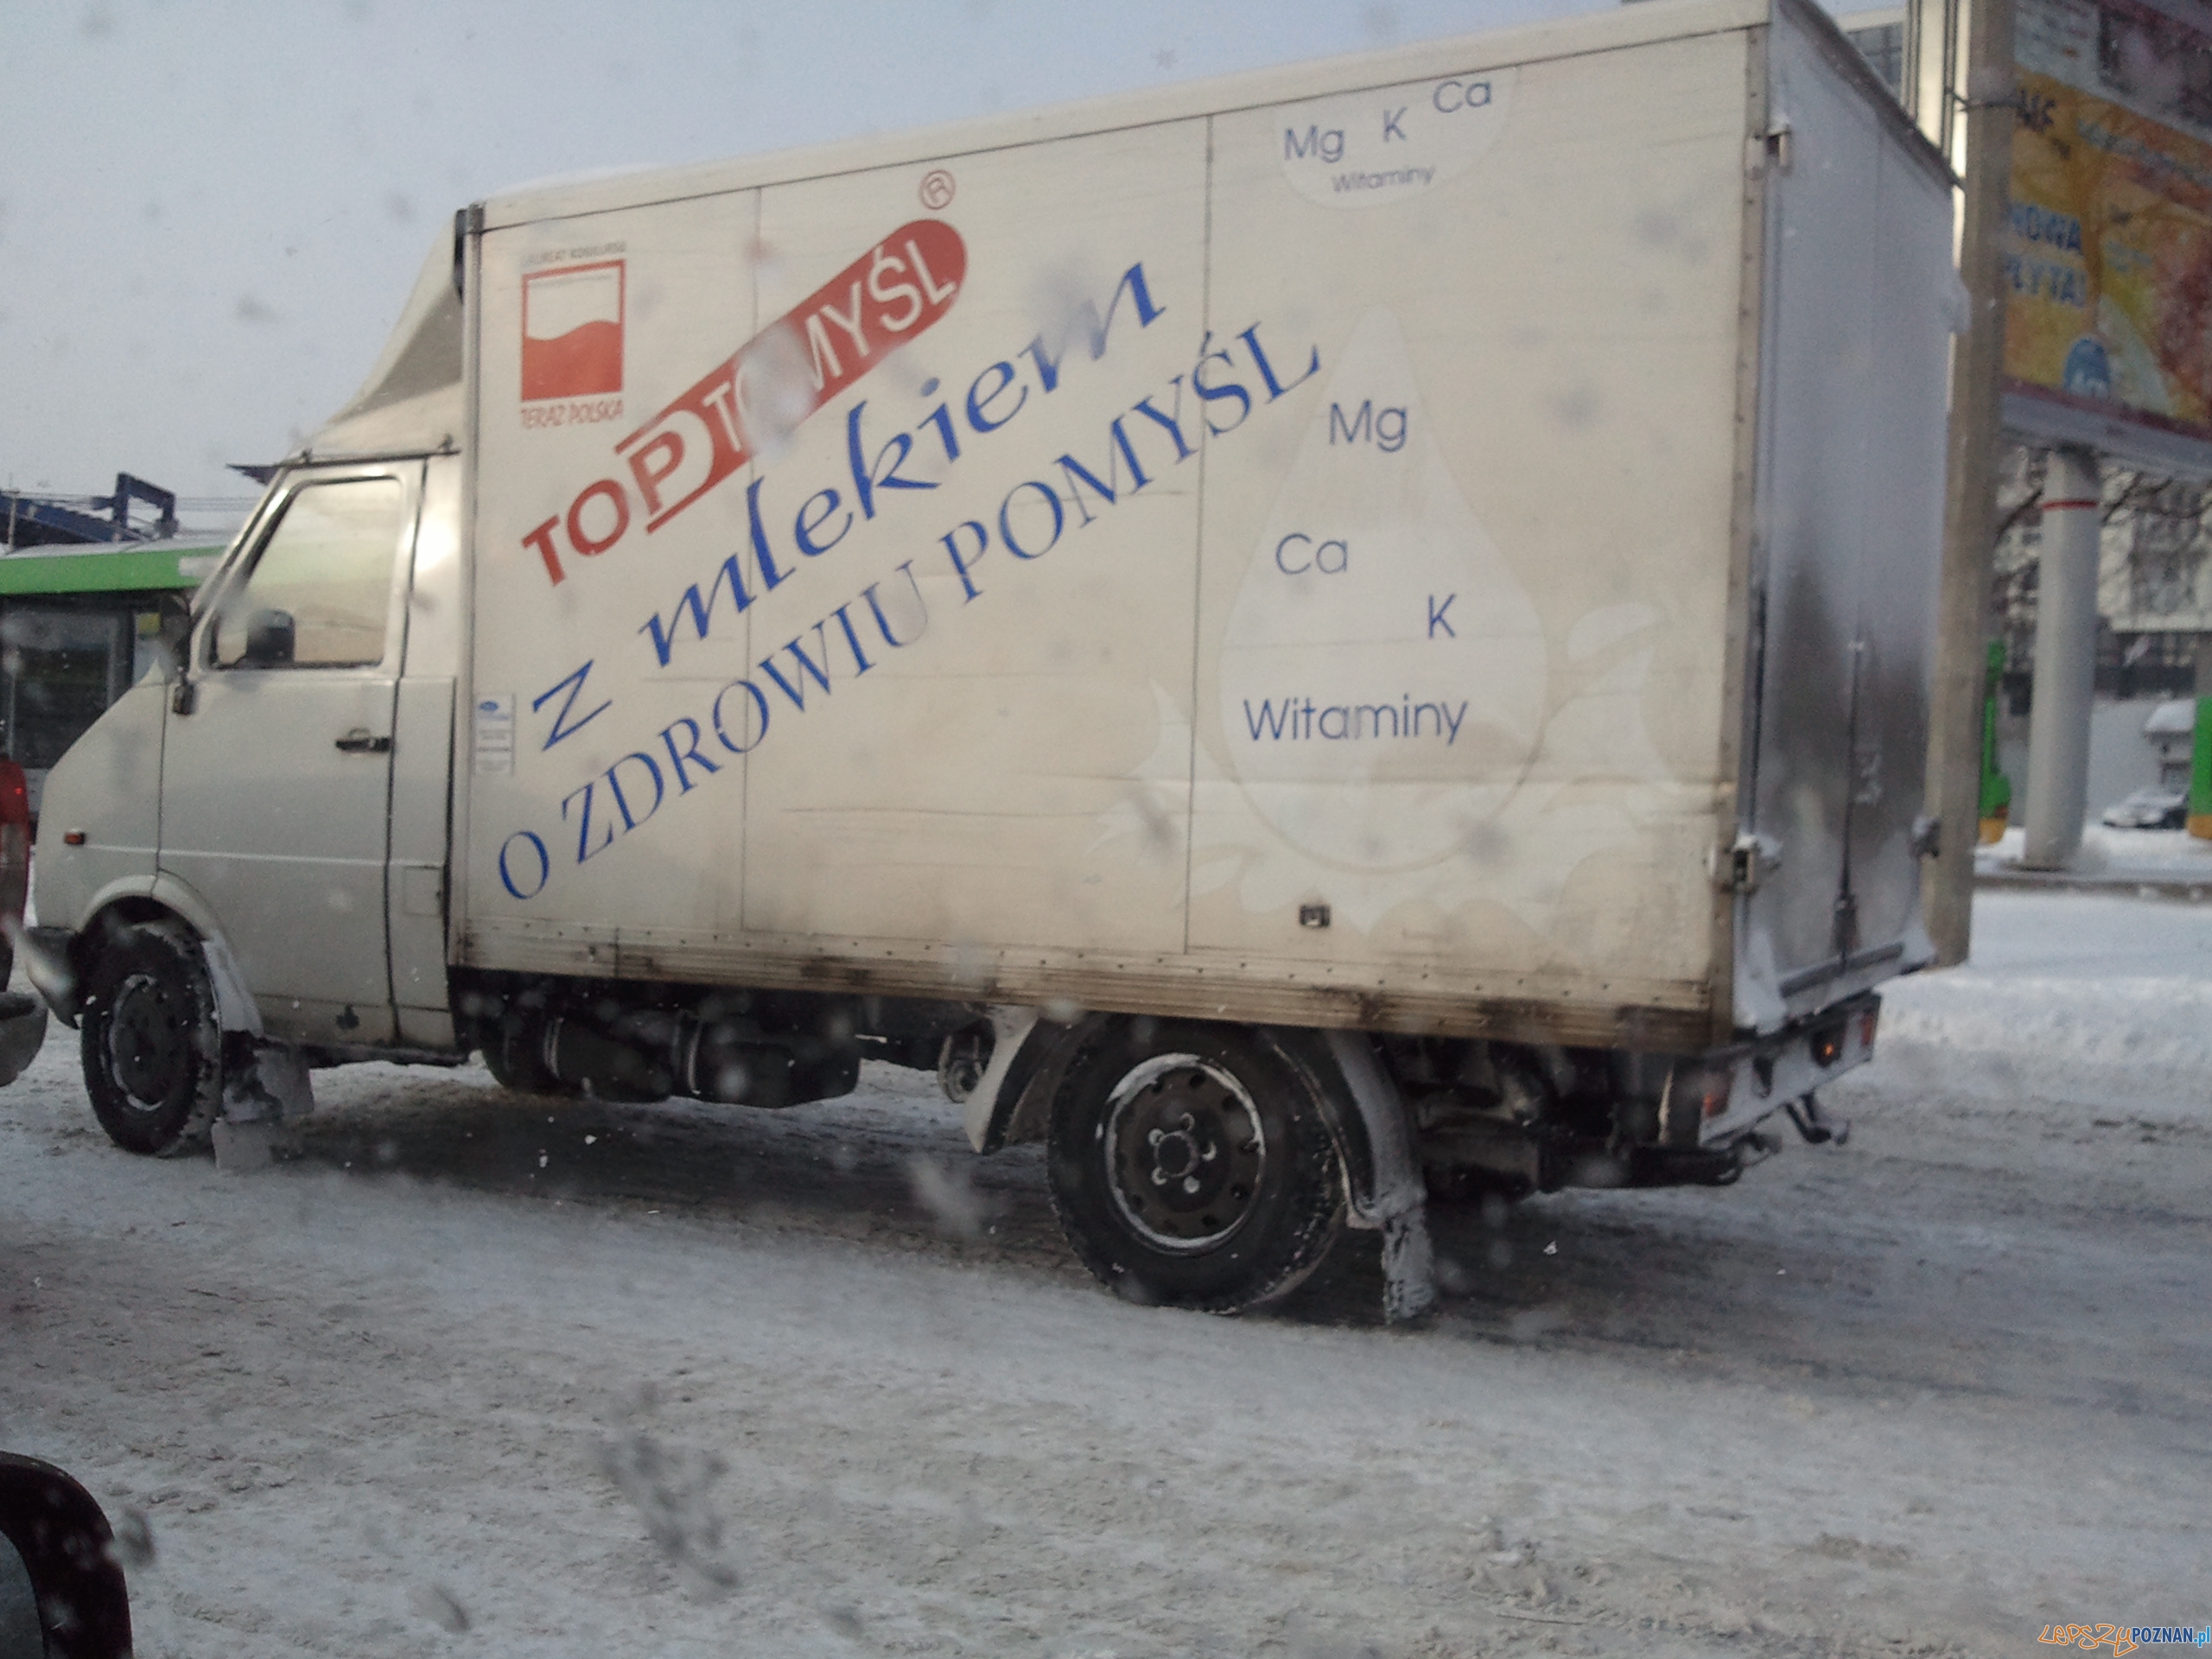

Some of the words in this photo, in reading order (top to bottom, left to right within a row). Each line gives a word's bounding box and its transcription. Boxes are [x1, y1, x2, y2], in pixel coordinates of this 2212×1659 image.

[1433, 80, 1492, 113] Ca
[1283, 124, 1344, 163] Mg
[1382, 106, 1408, 143] K
[1331, 165, 1437, 193] Witaminy
[521, 404, 565, 429] TERAZ
[569, 398, 624, 425] POLSKA
[521, 239, 958, 588] TOPTMYŚL
[1328, 399, 1408, 453] Mg
[638, 262, 1167, 668] mlekiem
[1274, 532, 1349, 575] Ca
[499, 830, 550, 900] O
[562, 559, 929, 865] ZDROWIU
[938, 321, 1321, 604] POMYŚL
[1427, 593, 1457, 639] K
[1243, 693, 1469, 747] Witaminy
